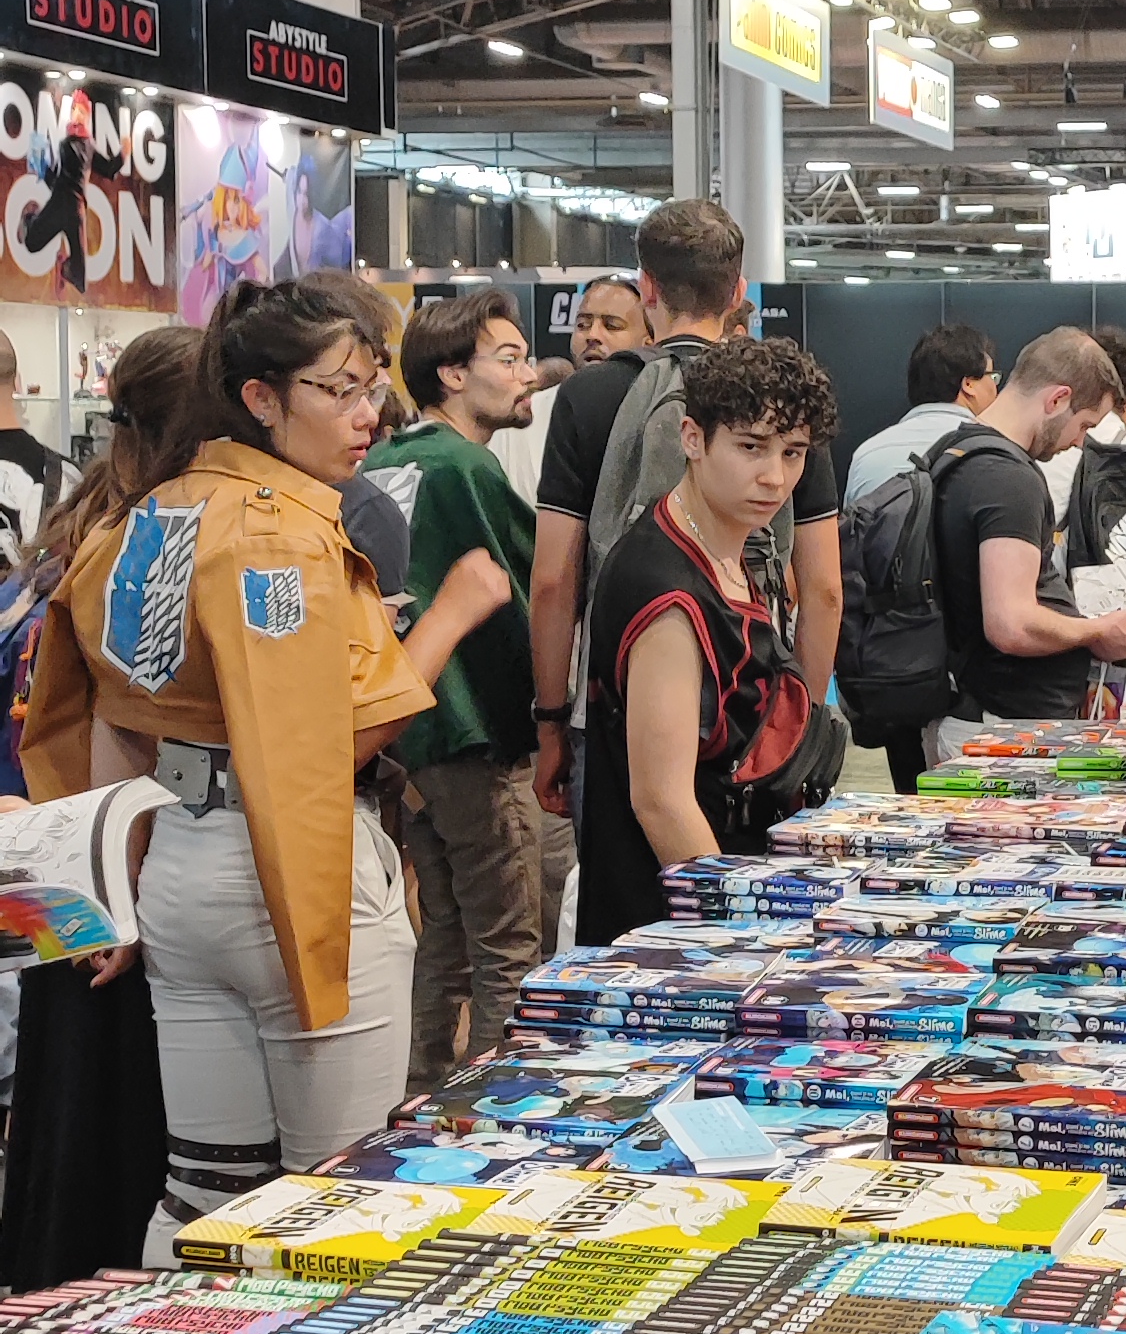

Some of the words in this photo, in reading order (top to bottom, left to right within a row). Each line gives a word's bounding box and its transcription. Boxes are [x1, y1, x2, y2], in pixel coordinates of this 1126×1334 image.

[268, 19, 328, 53] ABYSTYLE
[252, 40, 344, 92] STUDIO
[0, 171, 165, 287] OON
[974, 926, 1008, 941] Slime
[916, 1017, 956, 1033] Slime
[250, 1182, 383, 1239] REIGEN
[295, 1252, 361, 1276] REIGEN
[275, 1279, 342, 1298] PSYCHO
